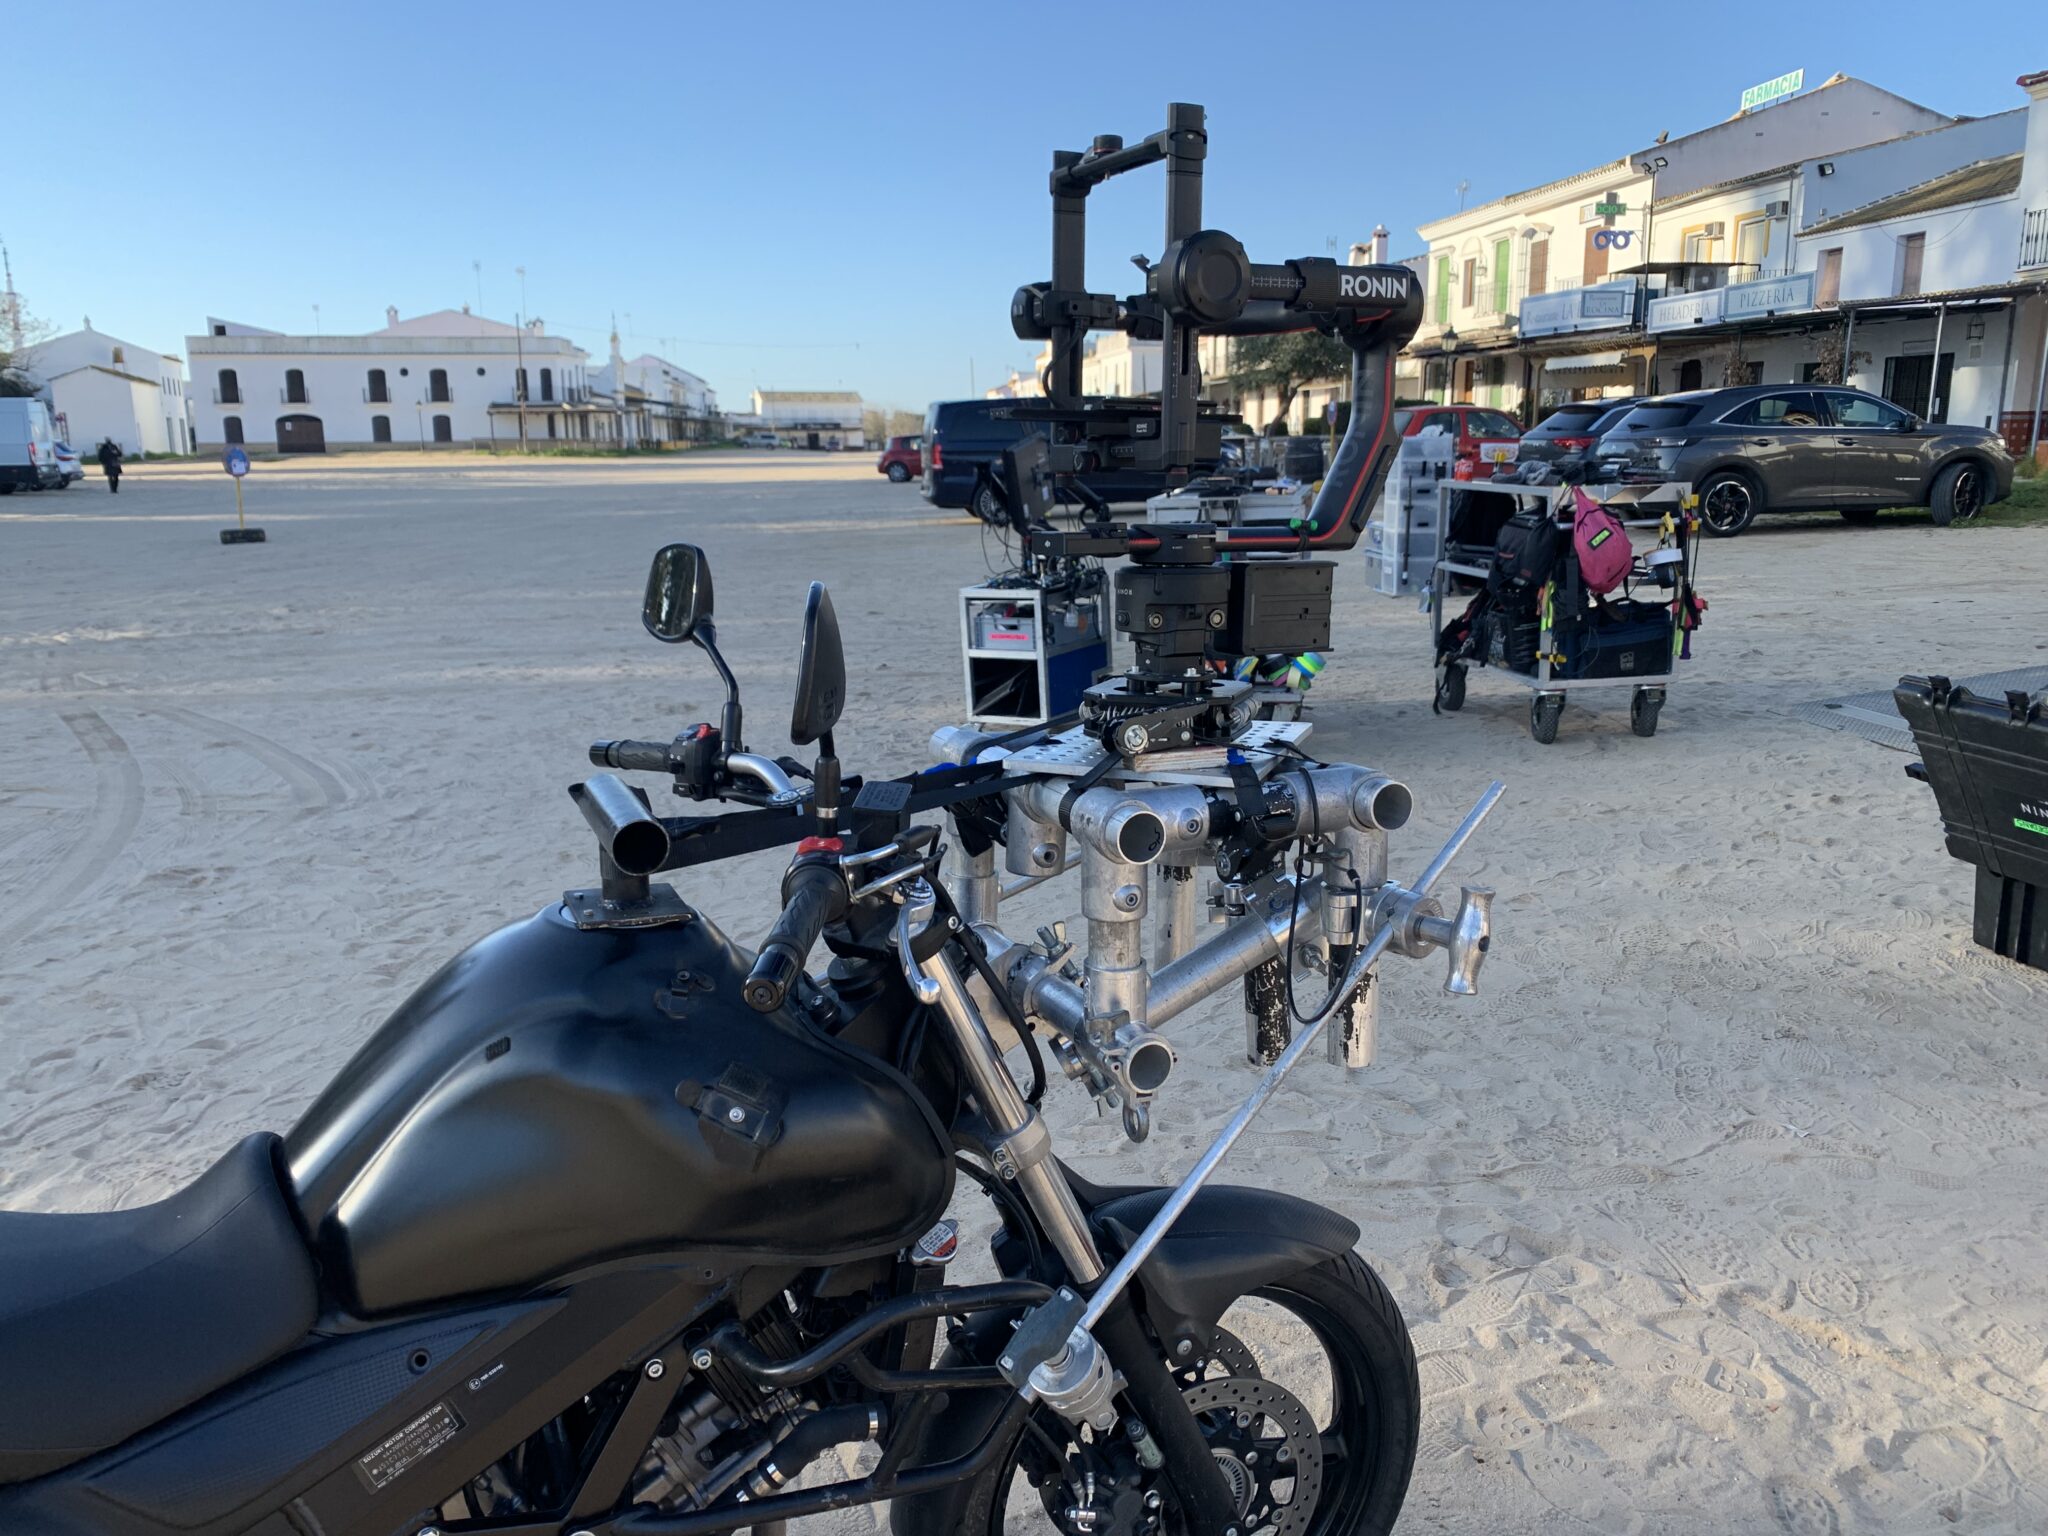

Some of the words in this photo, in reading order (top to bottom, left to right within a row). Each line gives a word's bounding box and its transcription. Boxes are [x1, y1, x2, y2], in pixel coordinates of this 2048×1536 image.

[1743, 71, 1801, 107] FARMACIA
[1340, 274, 1407, 299] RONIN
[362, 1445, 385, 1464] SUZUKI
[384, 1431, 405, 1449] MOTOR
[404, 1404, 443, 1434] CORPORATION
